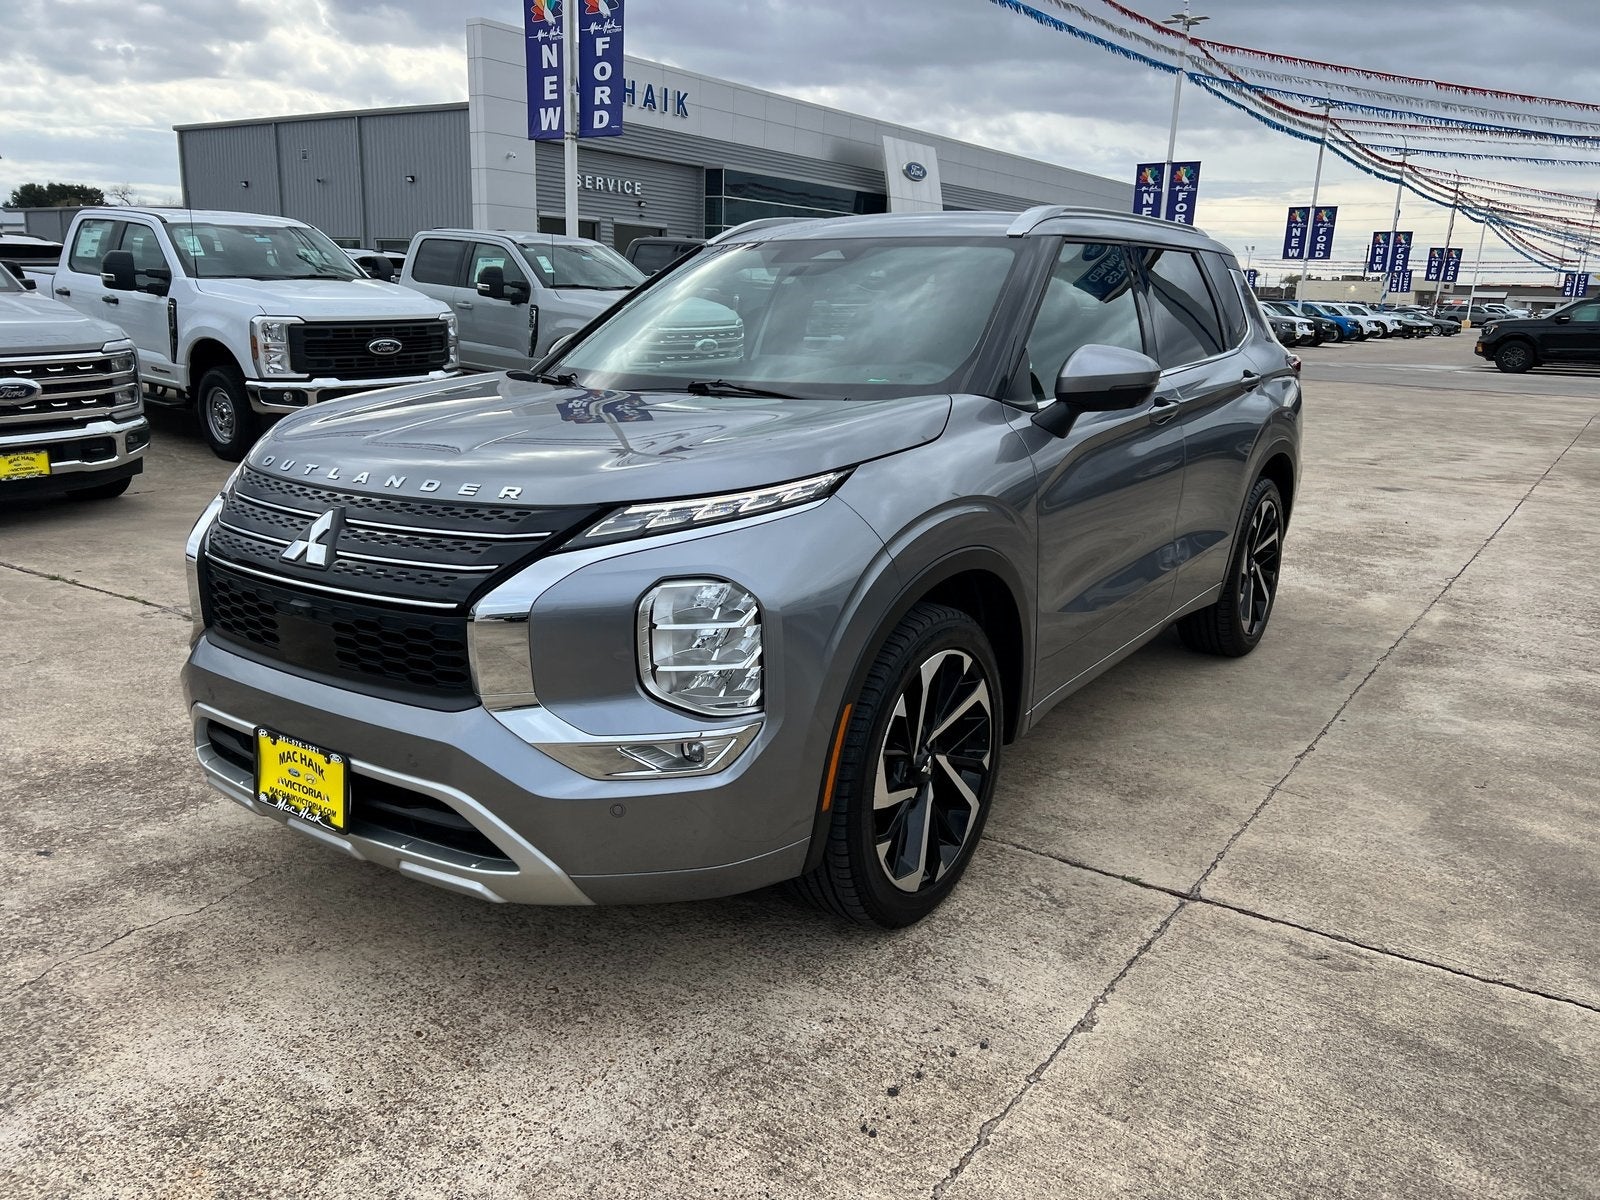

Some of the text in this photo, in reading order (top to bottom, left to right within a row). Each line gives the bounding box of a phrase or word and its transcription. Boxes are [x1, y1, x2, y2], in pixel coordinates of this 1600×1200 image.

[540, 43, 561, 131] NEW
[593, 37, 612, 129] FORD
[623, 78, 689, 118] HAIK
[577, 174, 642, 195] SERVICE
[1142, 193, 1154, 217] NE
[1175, 192, 1187, 223] FOR
[1288, 227, 1301, 257] NEW
[1315, 227, 1327, 257] FORD
[1373, 247, 1384, 271] NEW
[1395, 248, 1404, 271] FORD
[1429, 261, 1439, 280] NEW
[1446, 261, 1455, 280] FORD
[1564, 282, 1572, 296] NEW
[378, 342, 395, 351] Ford
[0, 385, 26, 398] Ford
[261, 455, 523, 500] OUTLANDER
[279, 750, 298, 765] MAC
[299, 752, 326, 781] HAIK
[283, 777, 323, 801] VICTORIA
[273, 797, 328, 826] Mac Haik
